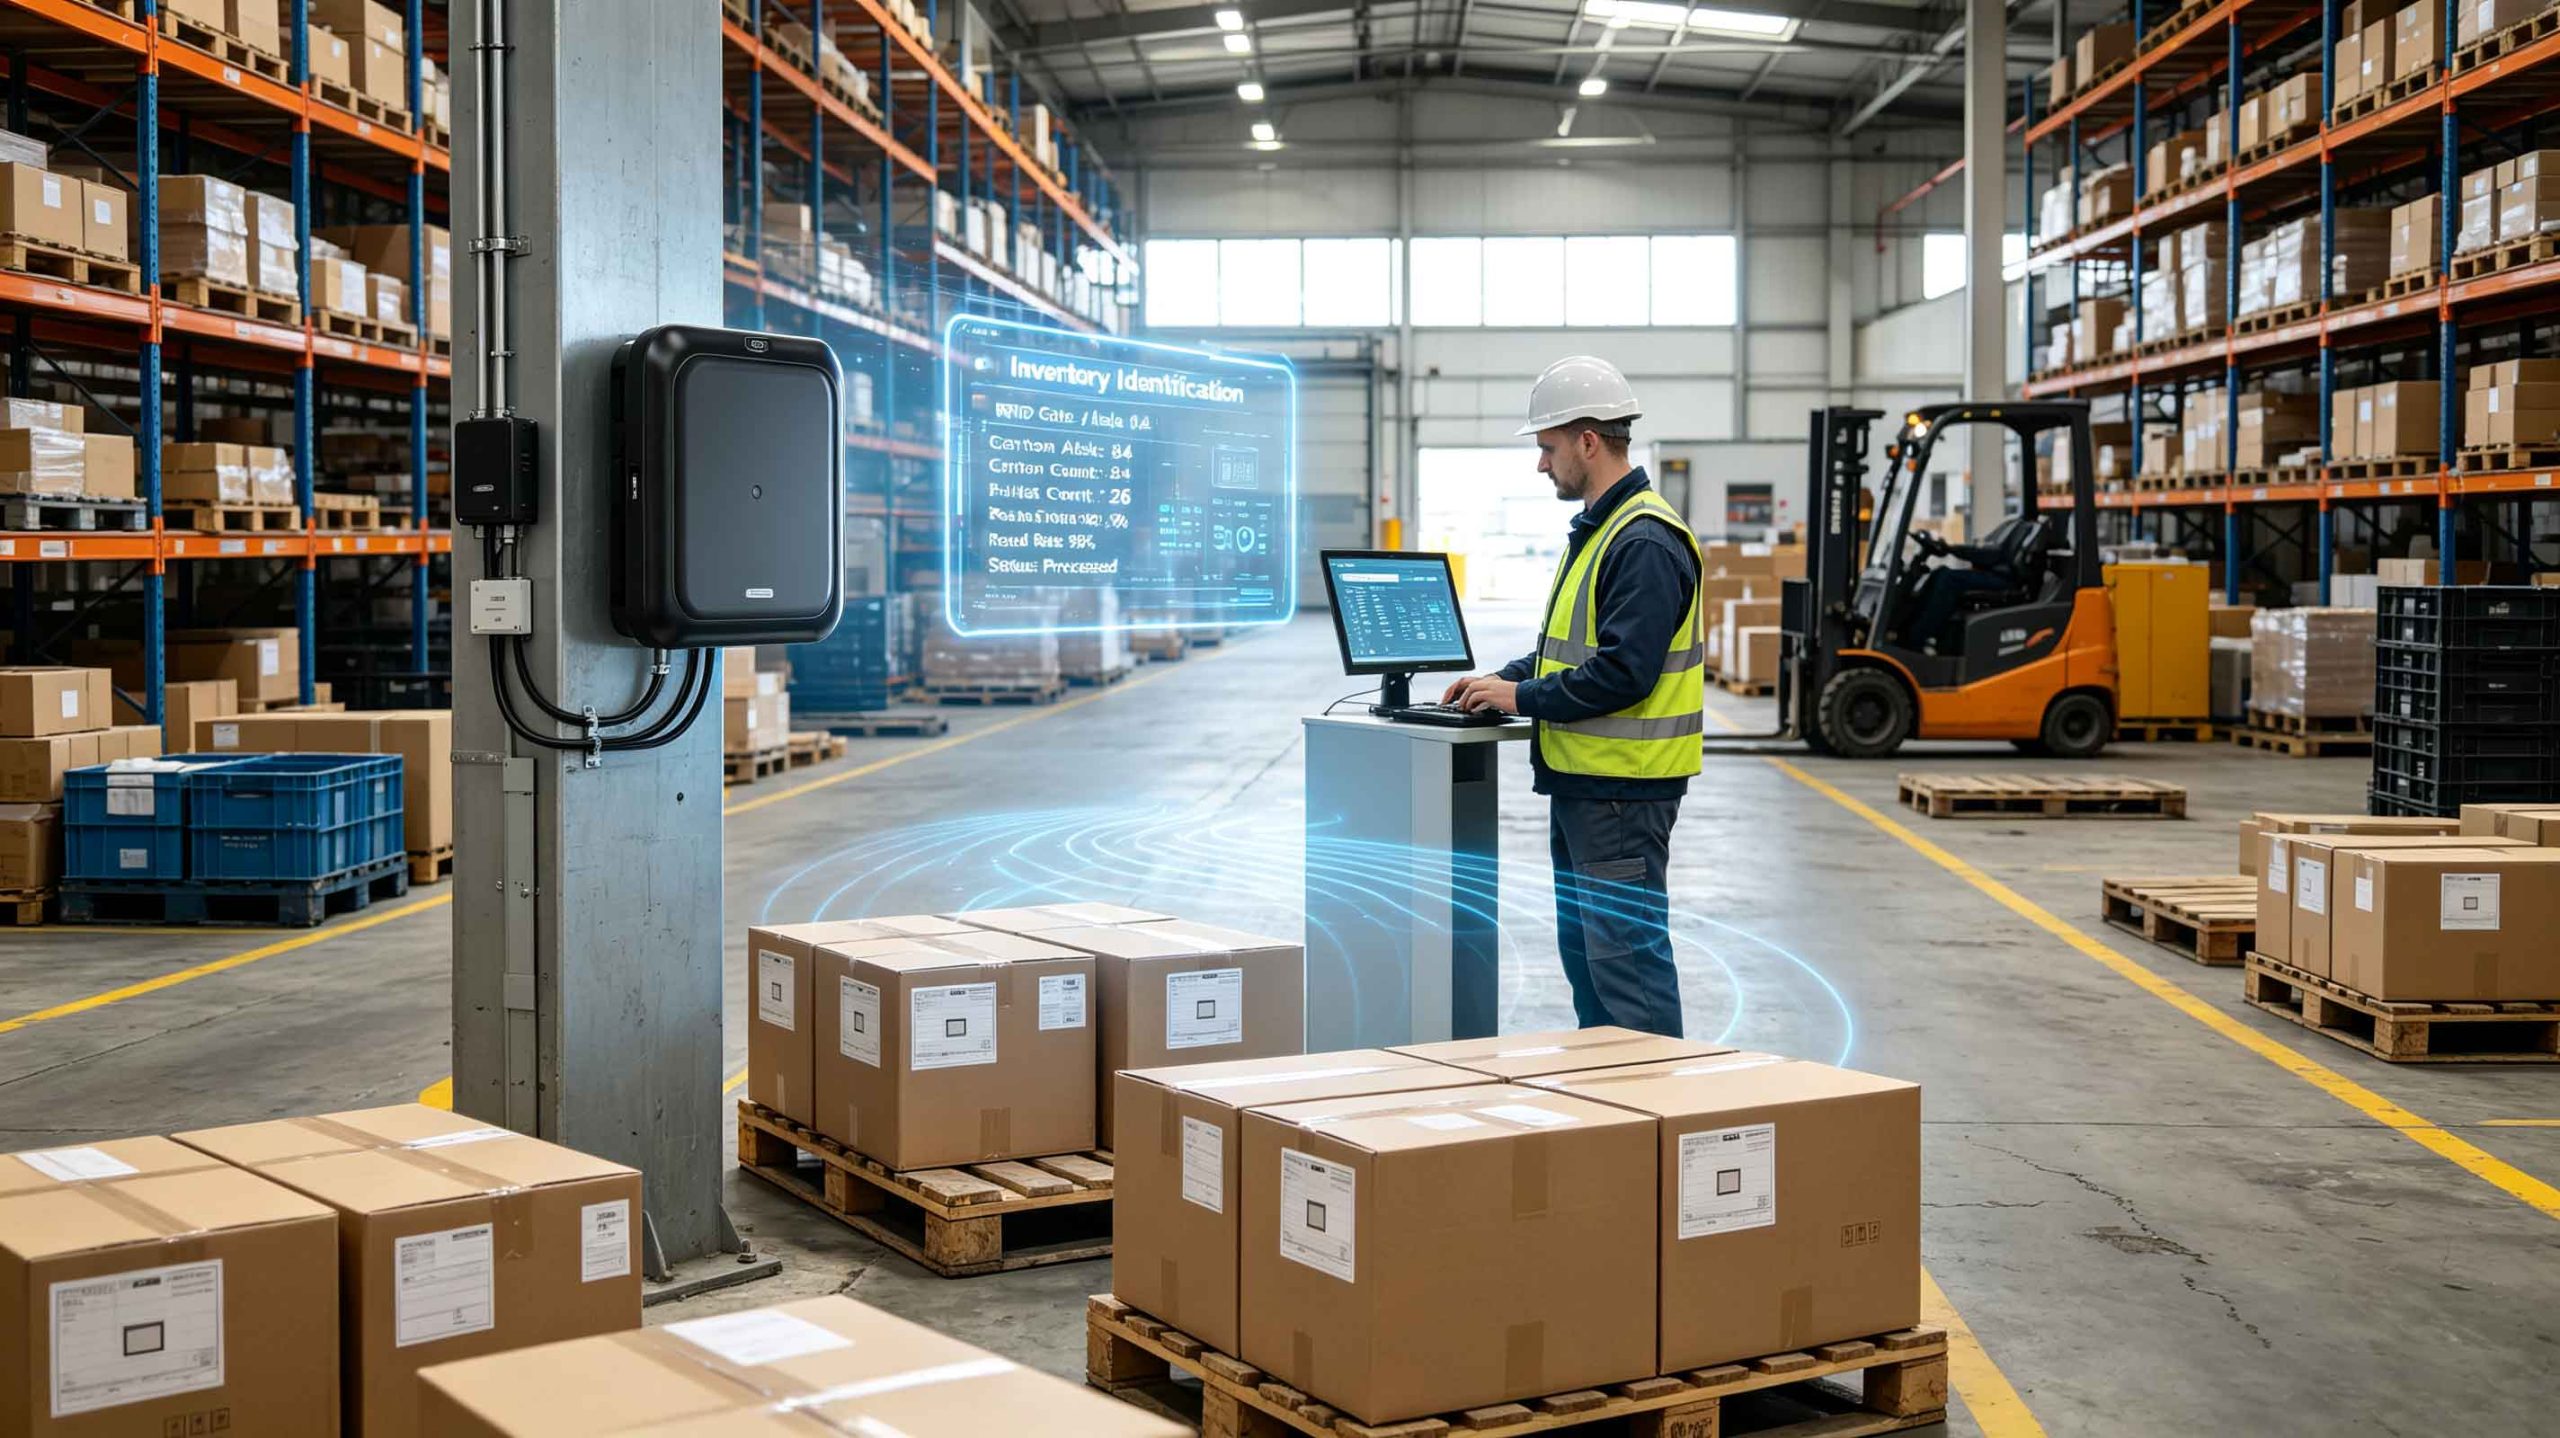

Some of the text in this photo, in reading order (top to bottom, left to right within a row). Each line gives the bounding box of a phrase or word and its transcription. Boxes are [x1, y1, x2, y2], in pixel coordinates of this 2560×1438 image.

[1010, 356, 1244, 403] Inventory Identification
[1108, 488, 1132, 505] 26
